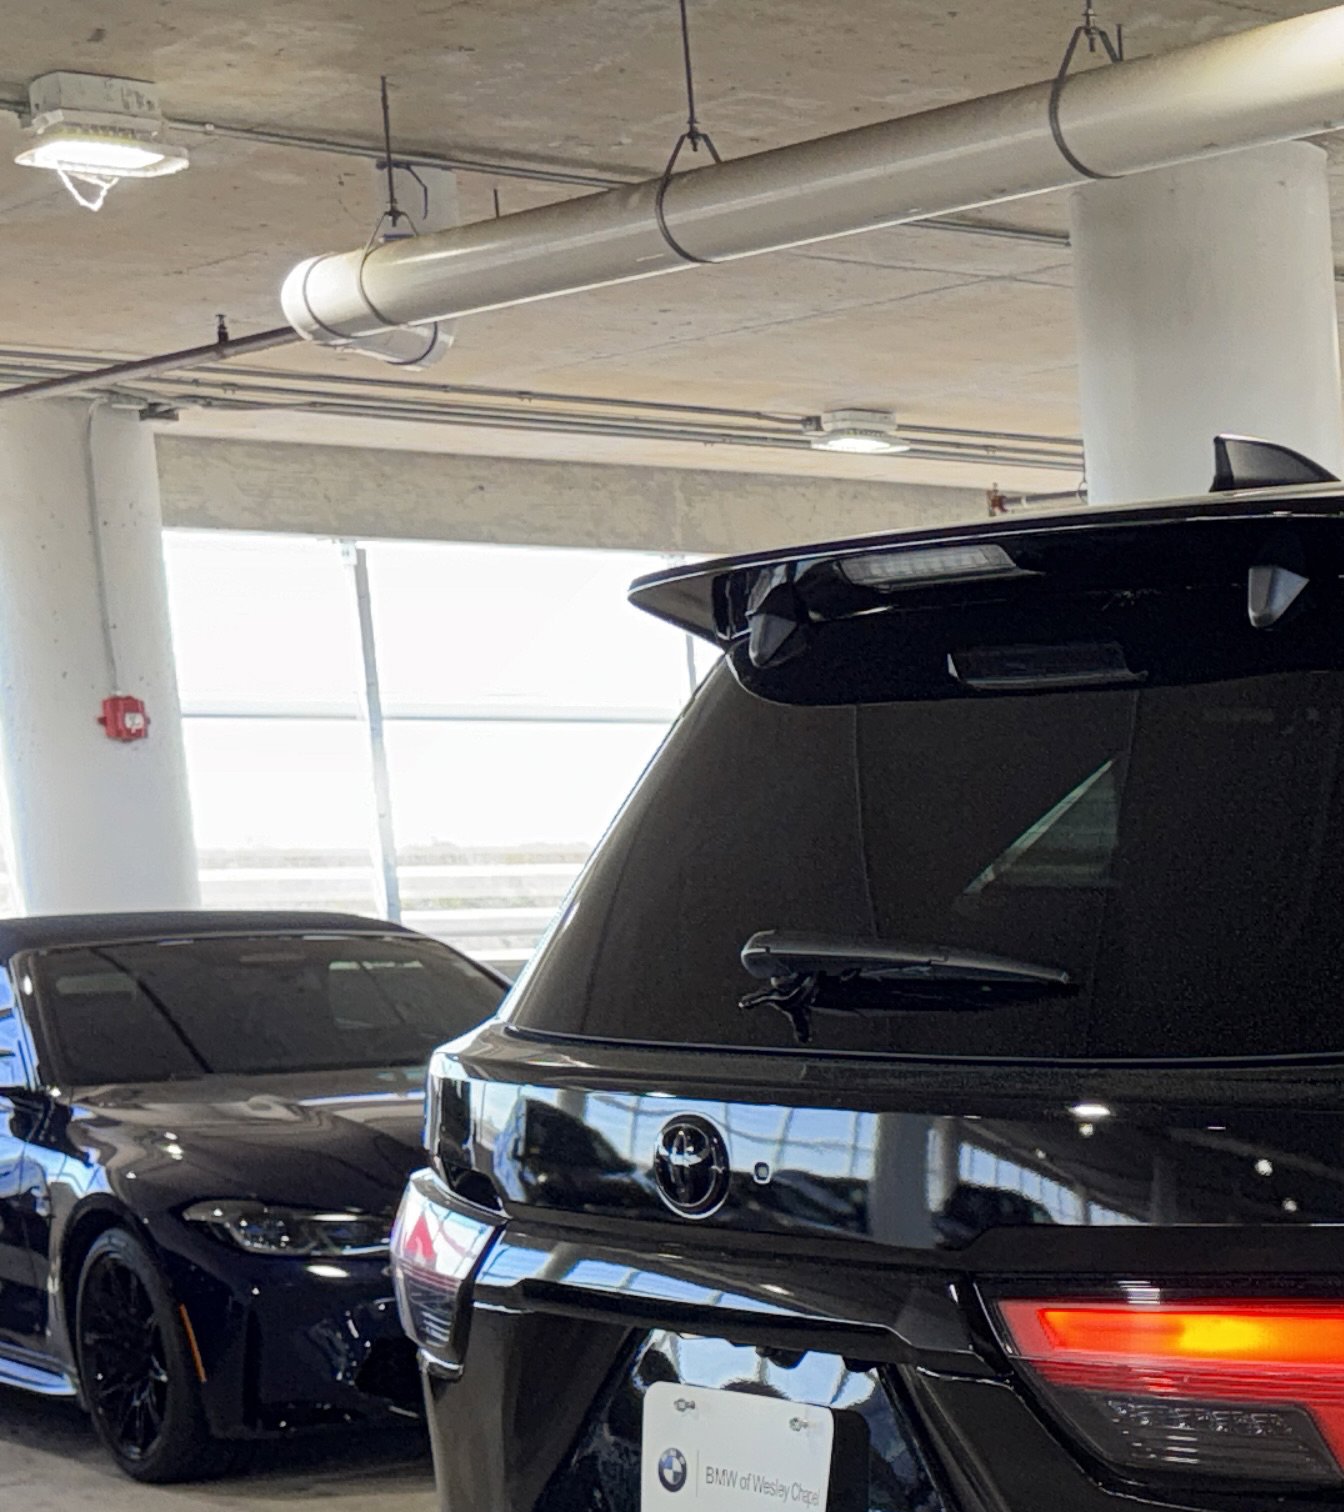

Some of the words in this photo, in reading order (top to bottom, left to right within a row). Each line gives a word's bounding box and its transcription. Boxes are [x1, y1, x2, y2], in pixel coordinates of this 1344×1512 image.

[705, 1466, 738, 1489] BMW
[739, 1473, 753, 1491] of
[752, 1474, 790, 1503] Wesley
